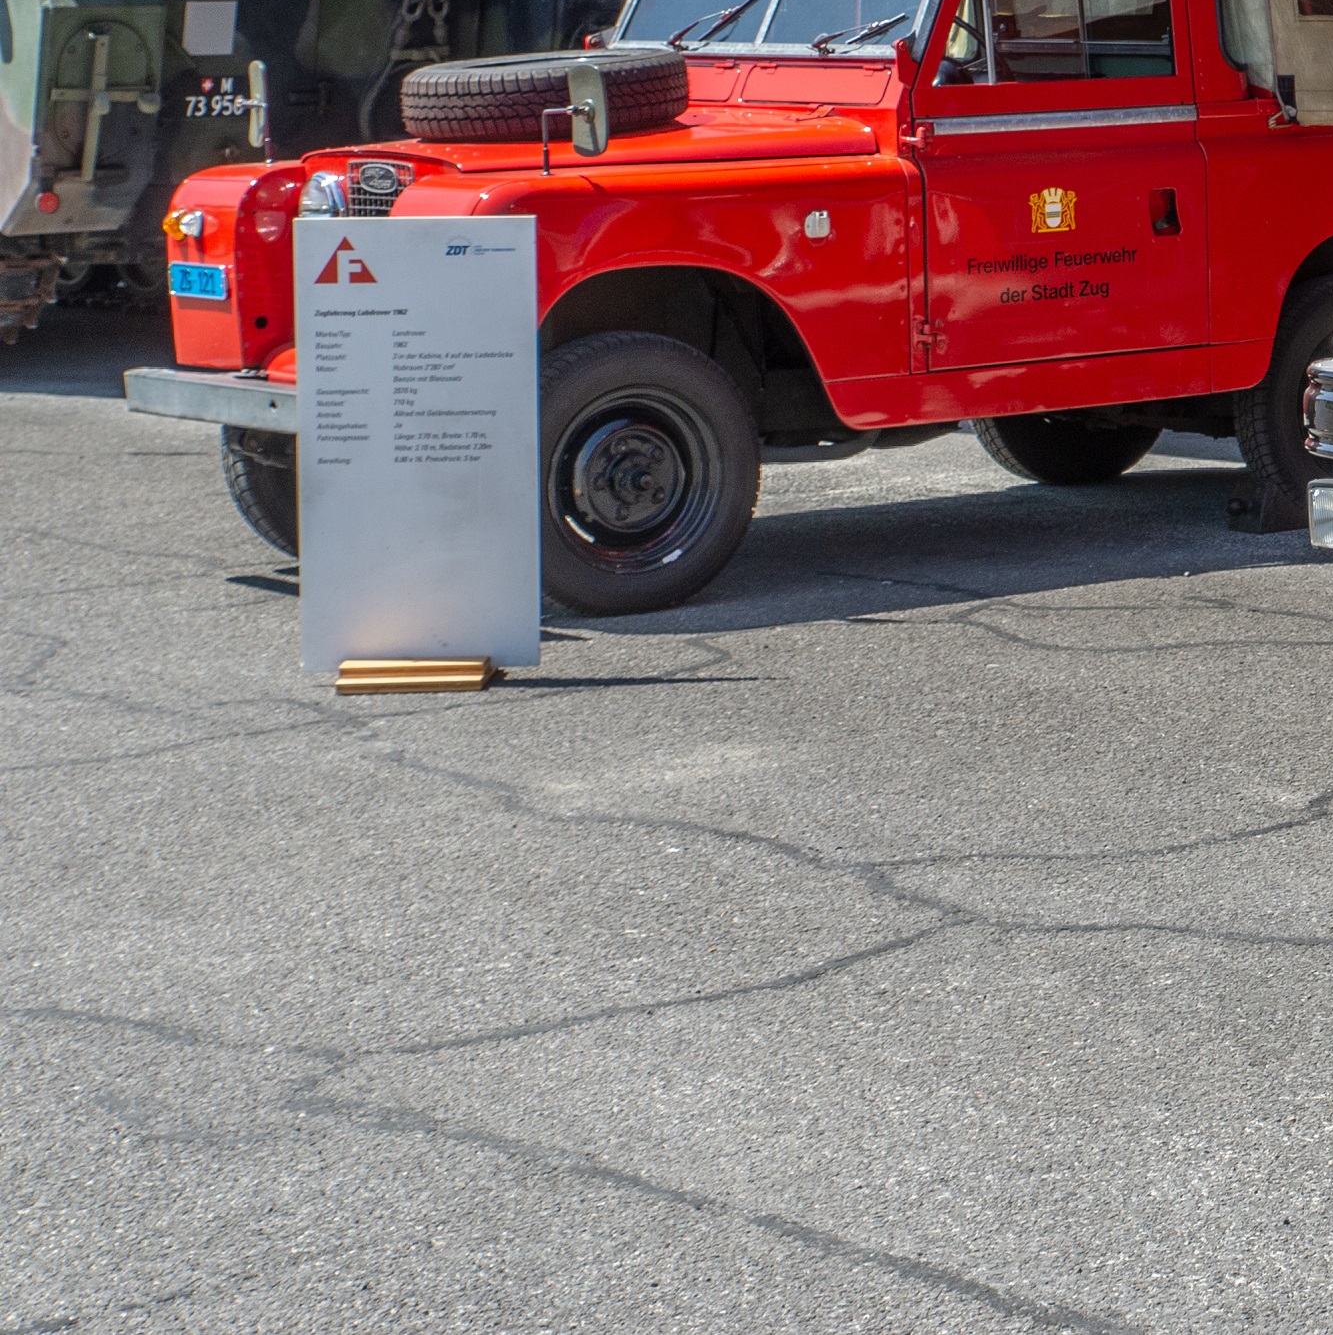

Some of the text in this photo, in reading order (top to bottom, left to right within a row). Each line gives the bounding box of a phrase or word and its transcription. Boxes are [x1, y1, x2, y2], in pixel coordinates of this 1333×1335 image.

[220, 77, 234, 93] M
[185, 95, 207, 117] 73
[445, 245, 470, 256] ZDT
[966, 247, 1138, 276] Freiwillige Feuerwehr
[999, 281, 1110, 304] der Stadt Zug
